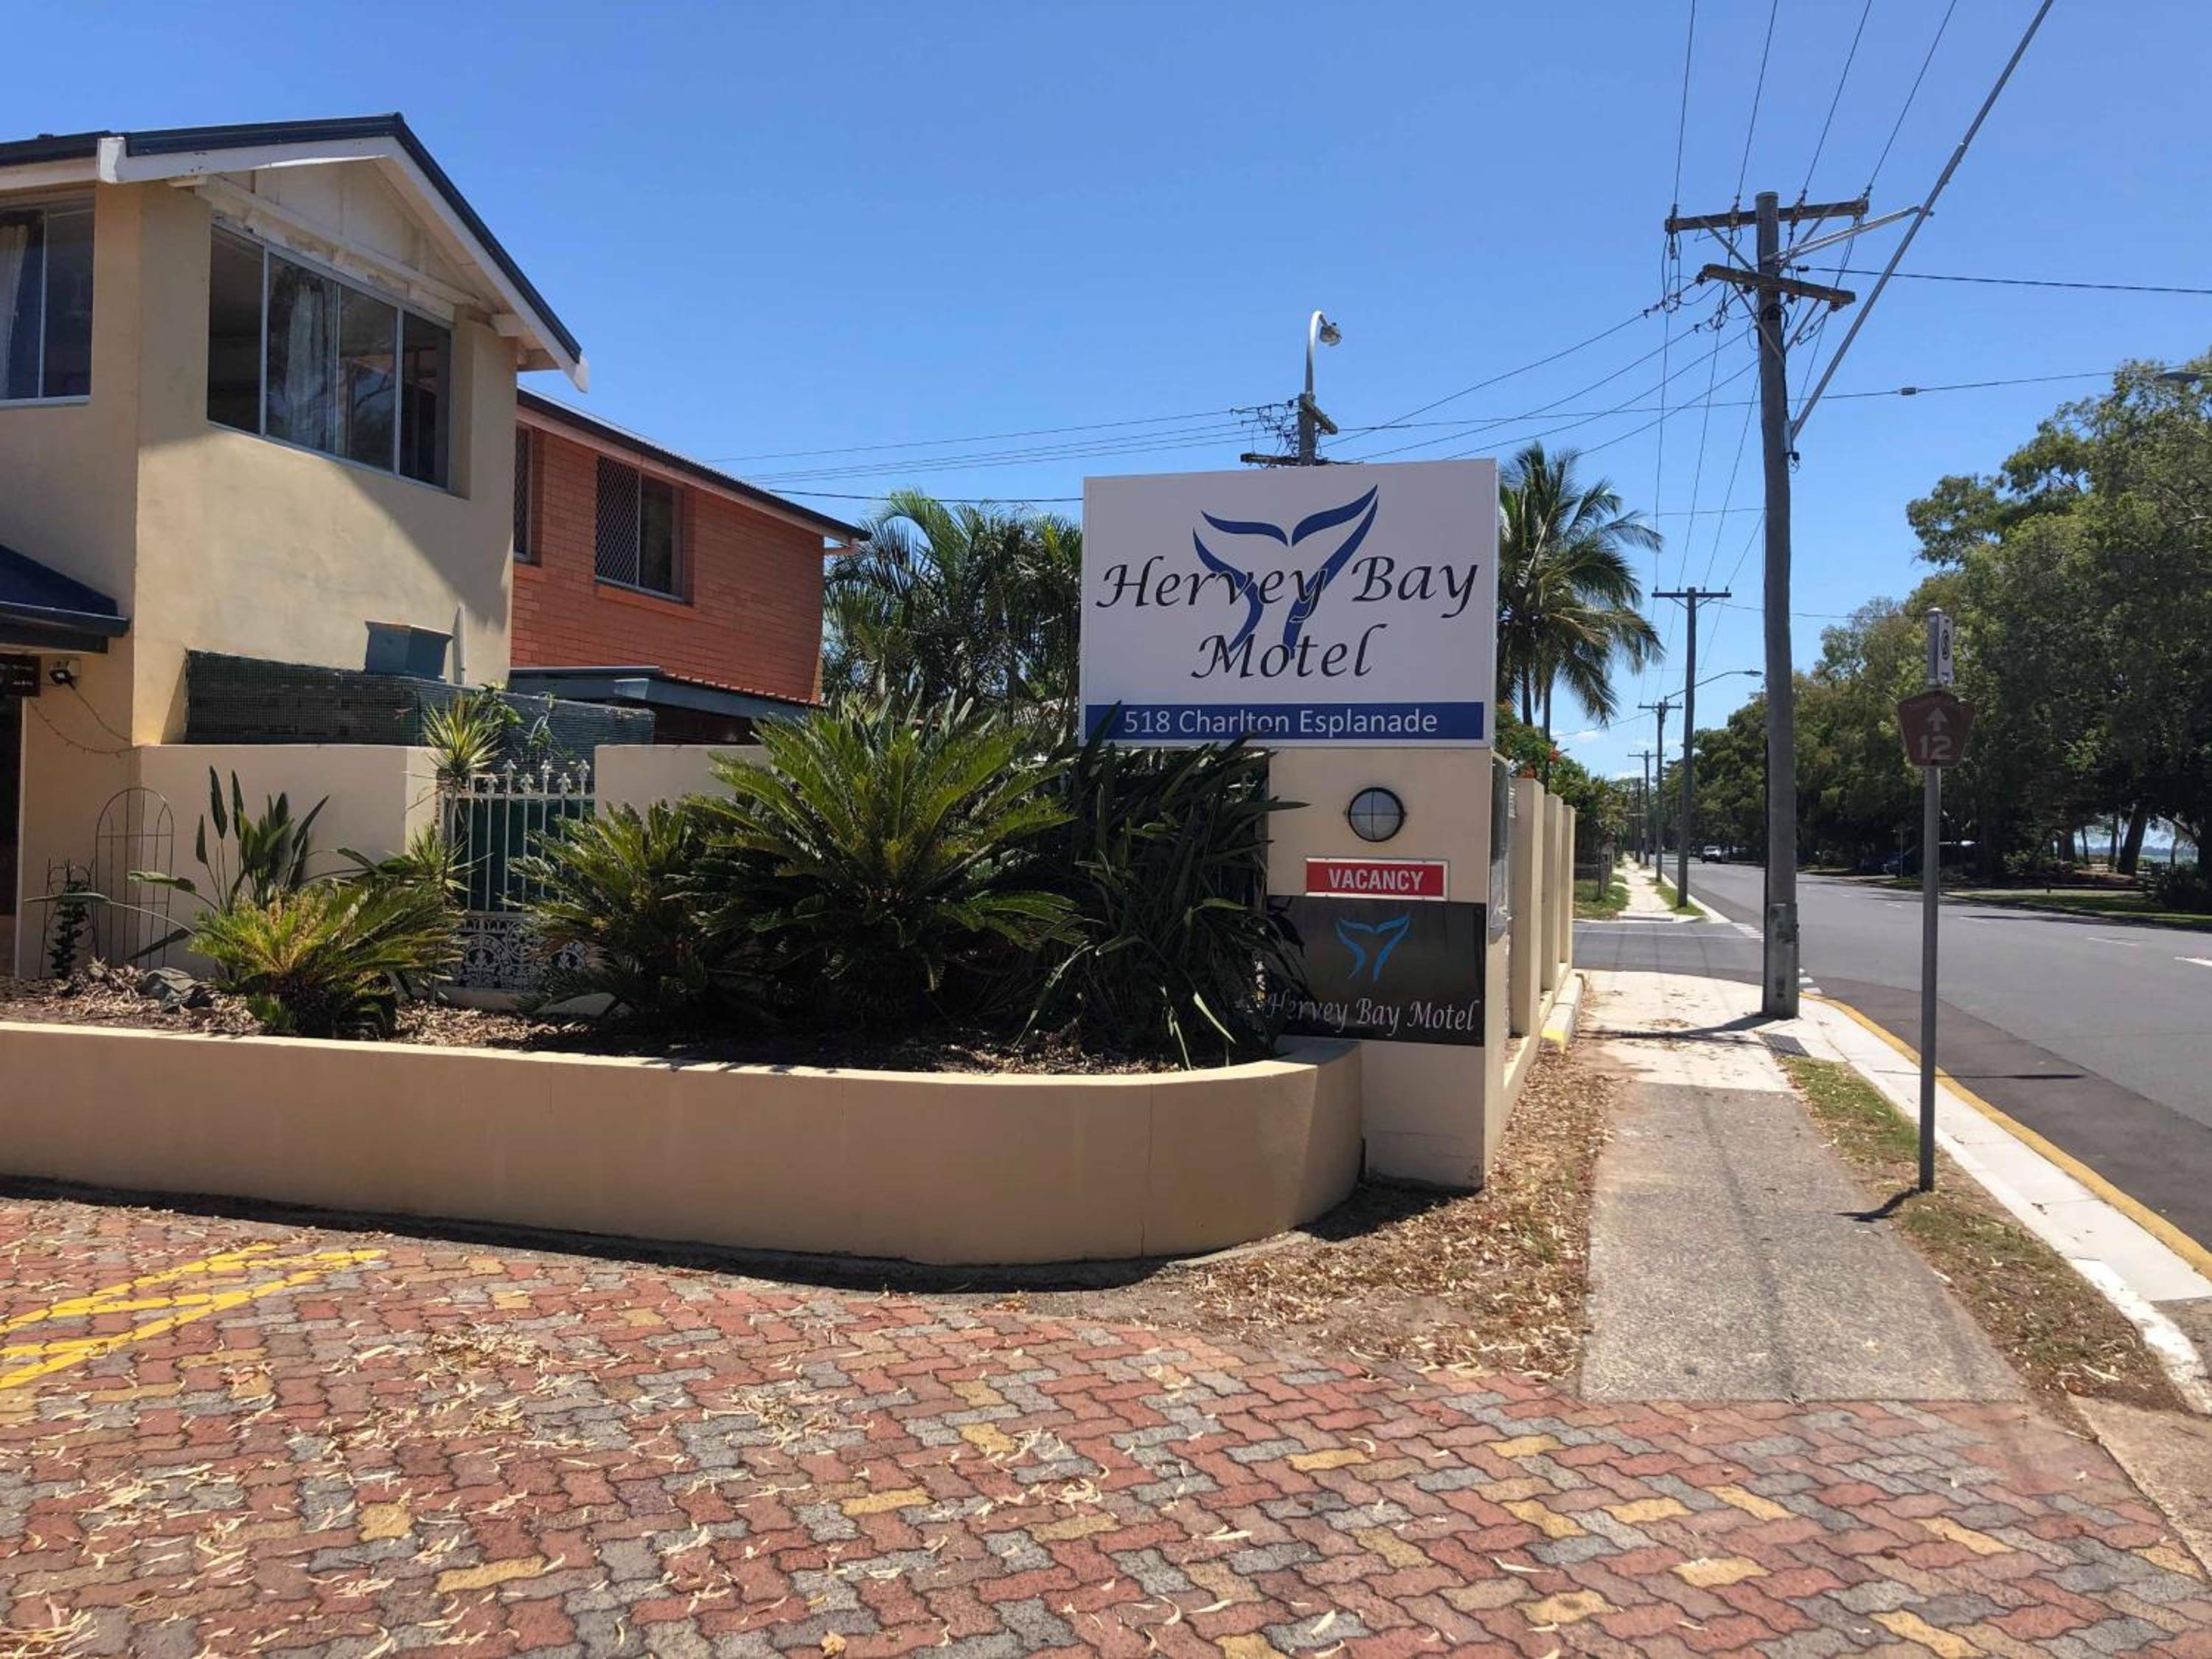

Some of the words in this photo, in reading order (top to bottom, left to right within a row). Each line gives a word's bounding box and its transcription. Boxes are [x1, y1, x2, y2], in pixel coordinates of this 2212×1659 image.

[1096, 556, 1329, 622] Hervey
[1351, 556, 1479, 619] Bay
[1191, 623, 1388, 679] Motel
[1124, 711, 1170, 733] 518
[1180, 709, 1290, 732] Charlton
[1300, 709, 1438, 738] Esplanade
[1920, 735, 1952, 760] 12
[1328, 868, 1424, 891] VACANCY
[1356, 998, 1400, 1036] Bay
[1407, 1000, 1481, 1031] Motel
